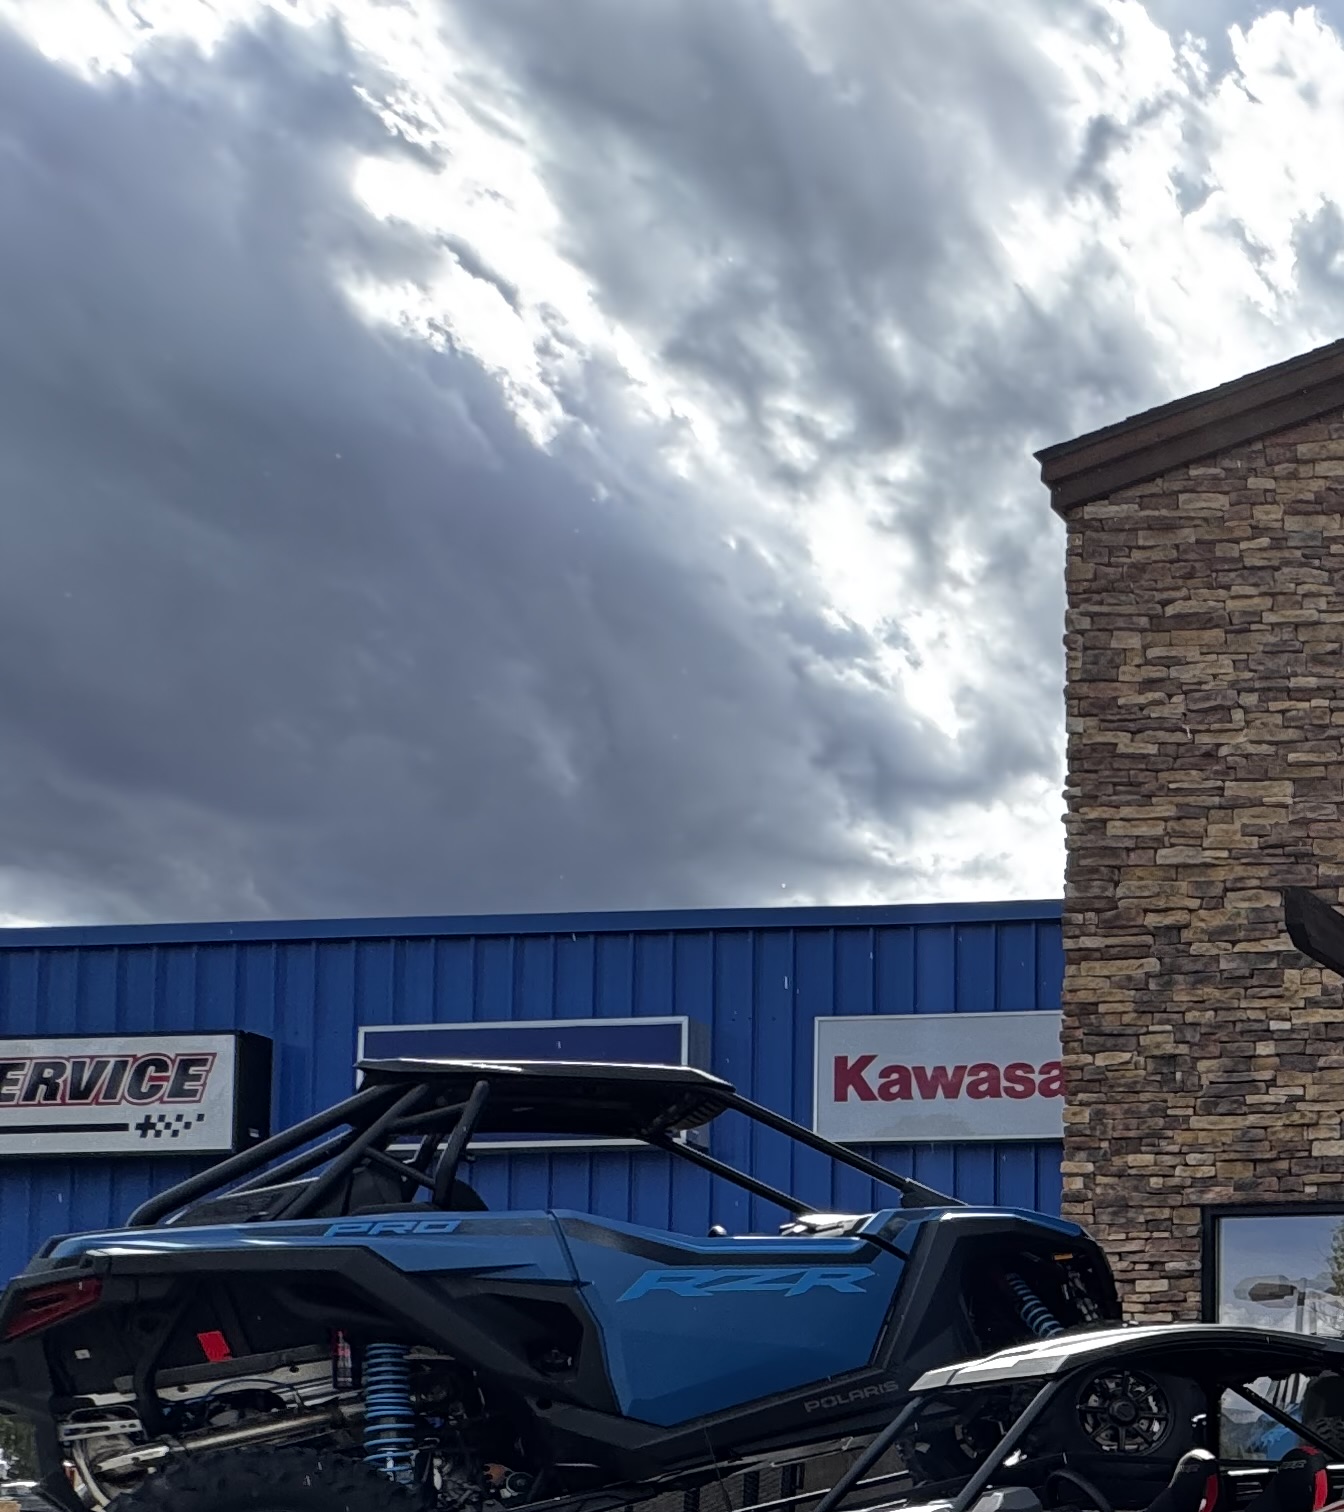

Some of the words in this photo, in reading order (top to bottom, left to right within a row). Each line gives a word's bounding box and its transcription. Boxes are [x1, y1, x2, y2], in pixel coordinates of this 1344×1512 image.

[323, 1219, 462, 1238] PRO
[615, 1267, 876, 1303] RZR
[803, 1380, 899, 1414] POLARIS
